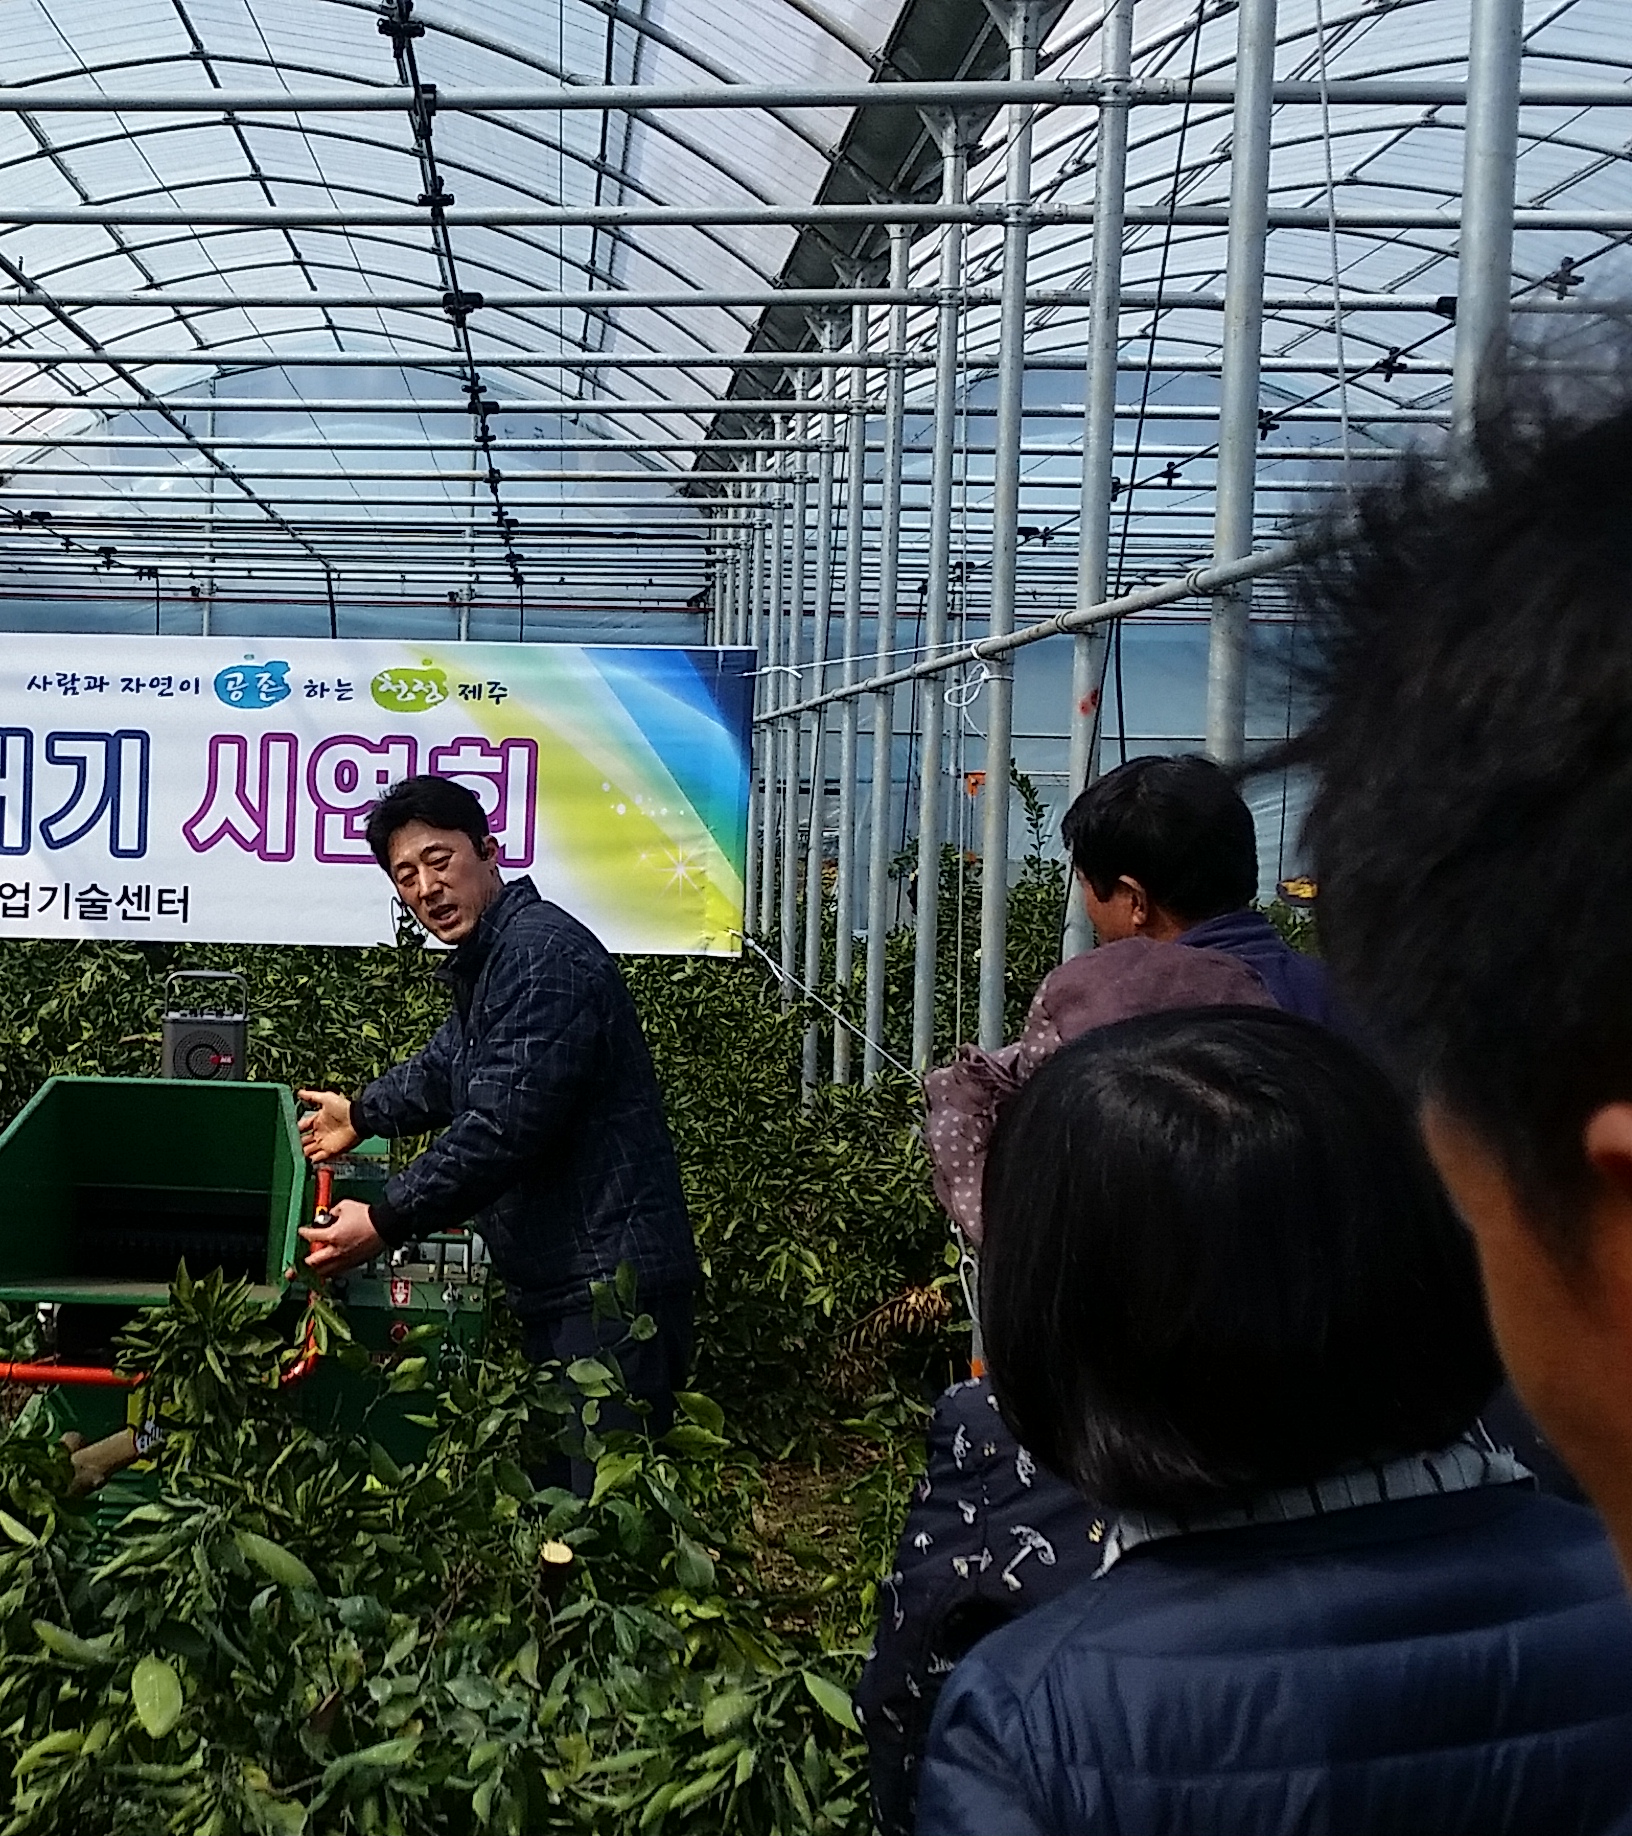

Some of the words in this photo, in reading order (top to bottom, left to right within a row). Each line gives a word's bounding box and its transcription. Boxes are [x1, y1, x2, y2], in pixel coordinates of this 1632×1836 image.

[26, 673, 110, 697] 사람과
[120, 674, 201, 698] 자연이
[223, 670, 286, 702] 공존
[303, 677, 355, 702] 하는
[457, 680, 509, 706] 제주
